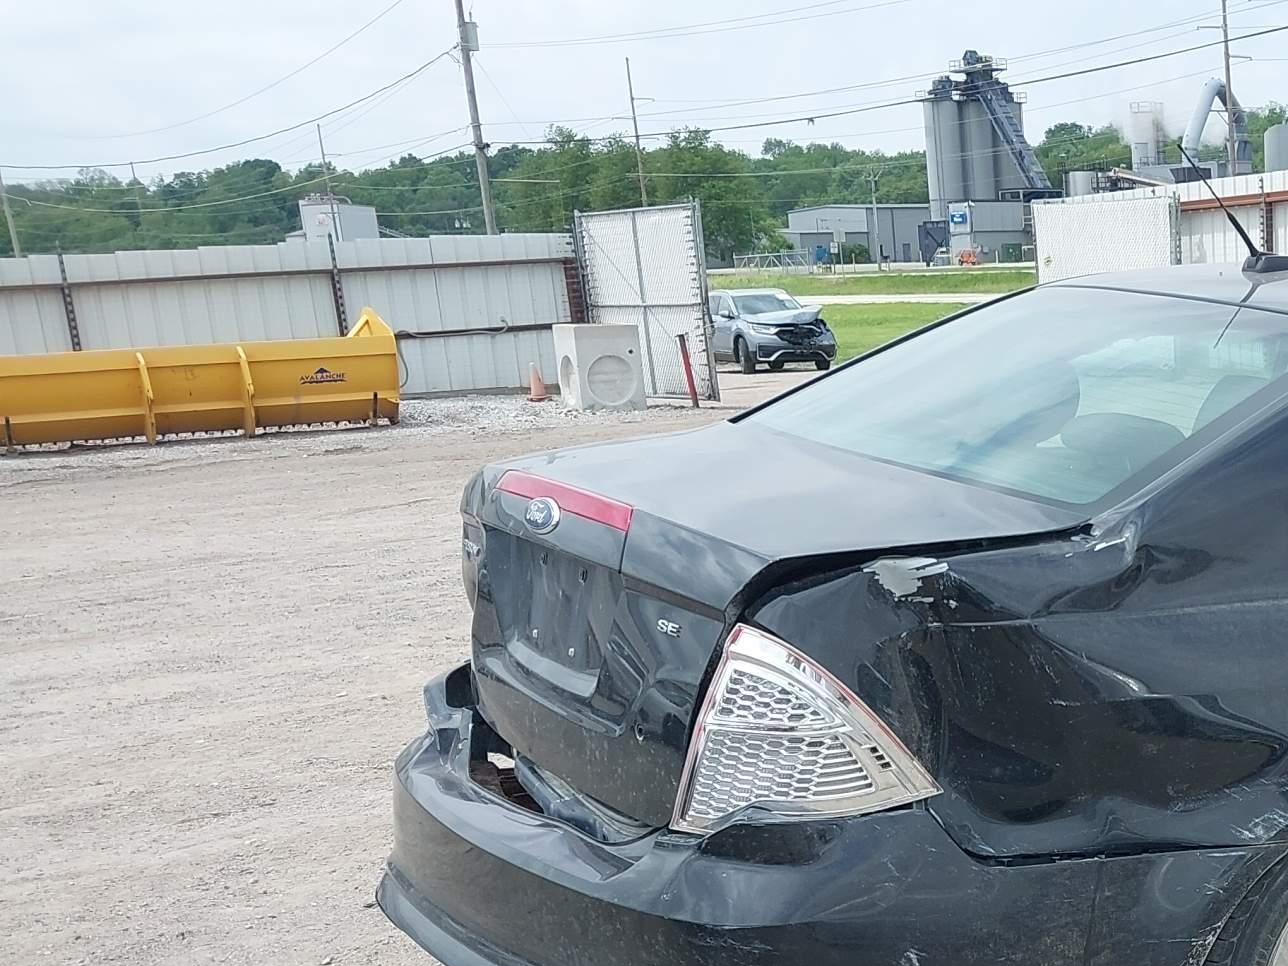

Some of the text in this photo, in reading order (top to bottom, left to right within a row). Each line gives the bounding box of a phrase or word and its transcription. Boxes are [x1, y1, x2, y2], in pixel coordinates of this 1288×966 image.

[300, 373, 345, 381] AVALANCHE
[526, 501, 547, 523] Ford
[657, 619, 680, 637] SE
